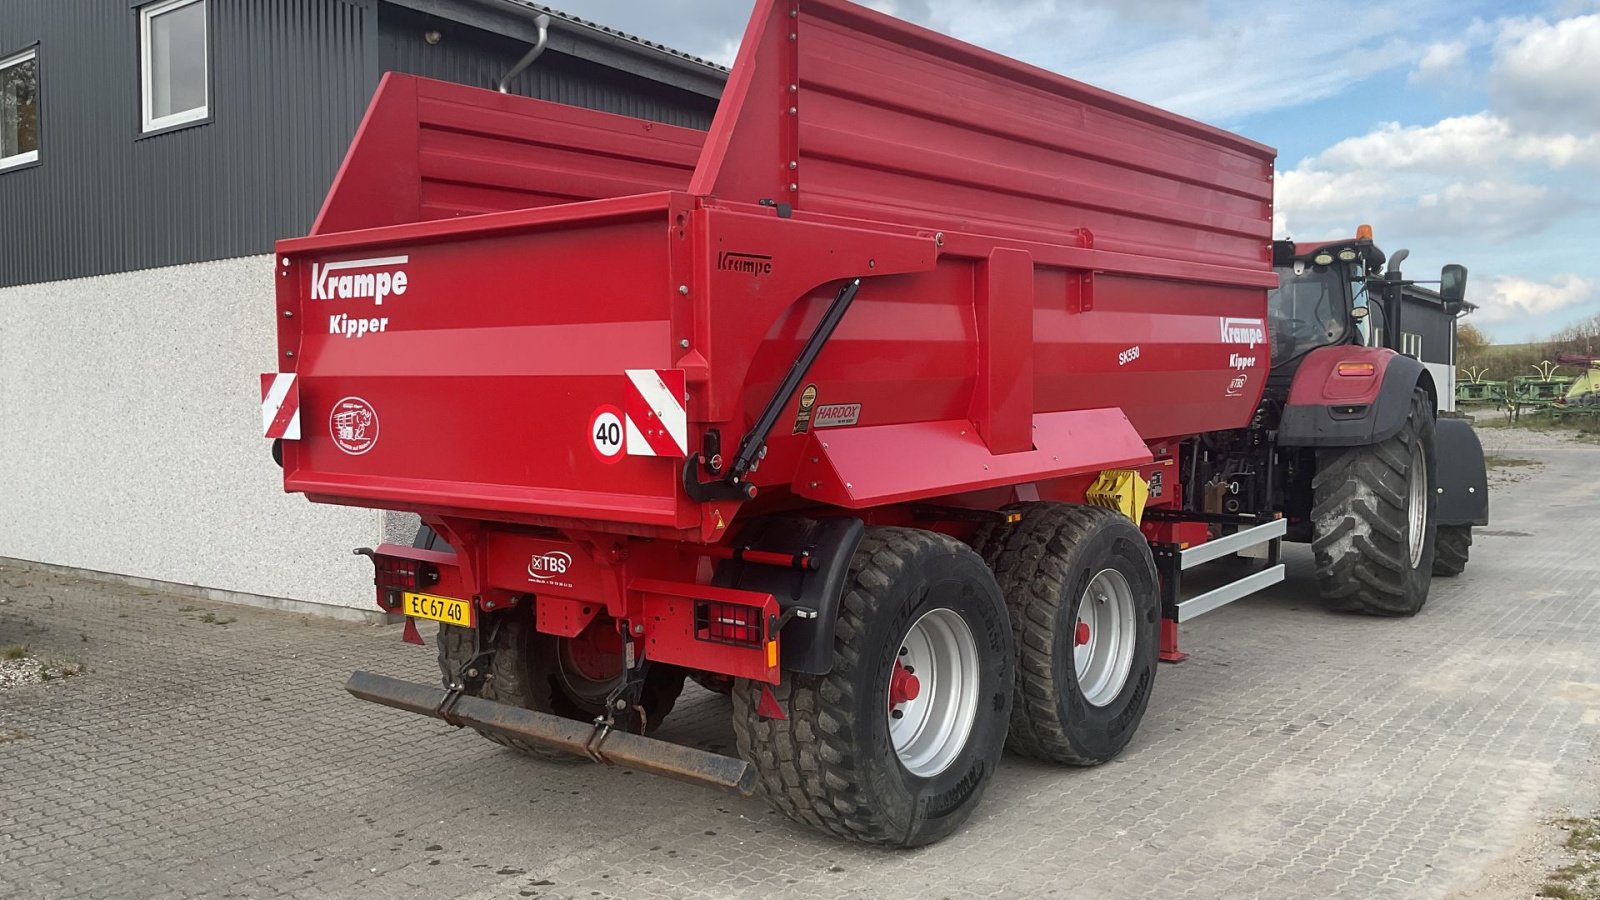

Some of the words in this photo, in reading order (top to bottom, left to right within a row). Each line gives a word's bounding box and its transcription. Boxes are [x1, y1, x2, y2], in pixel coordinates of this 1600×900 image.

[717, 251, 773, 277] Krampe
[311, 255, 409, 305] Krampe
[329, 313, 389, 338] Kipper
[1219, 316, 1263, 349] Krampe
[1118, 345, 1140, 366] SK550
[1229, 353, 1256, 370] Kipper
[817, 406, 858, 419] HARDOX
[596, 422, 620, 446] 40
[412, 596, 428, 615] EC
[430, 599, 445, 618] 67
[448, 602, 462, 621] 40
